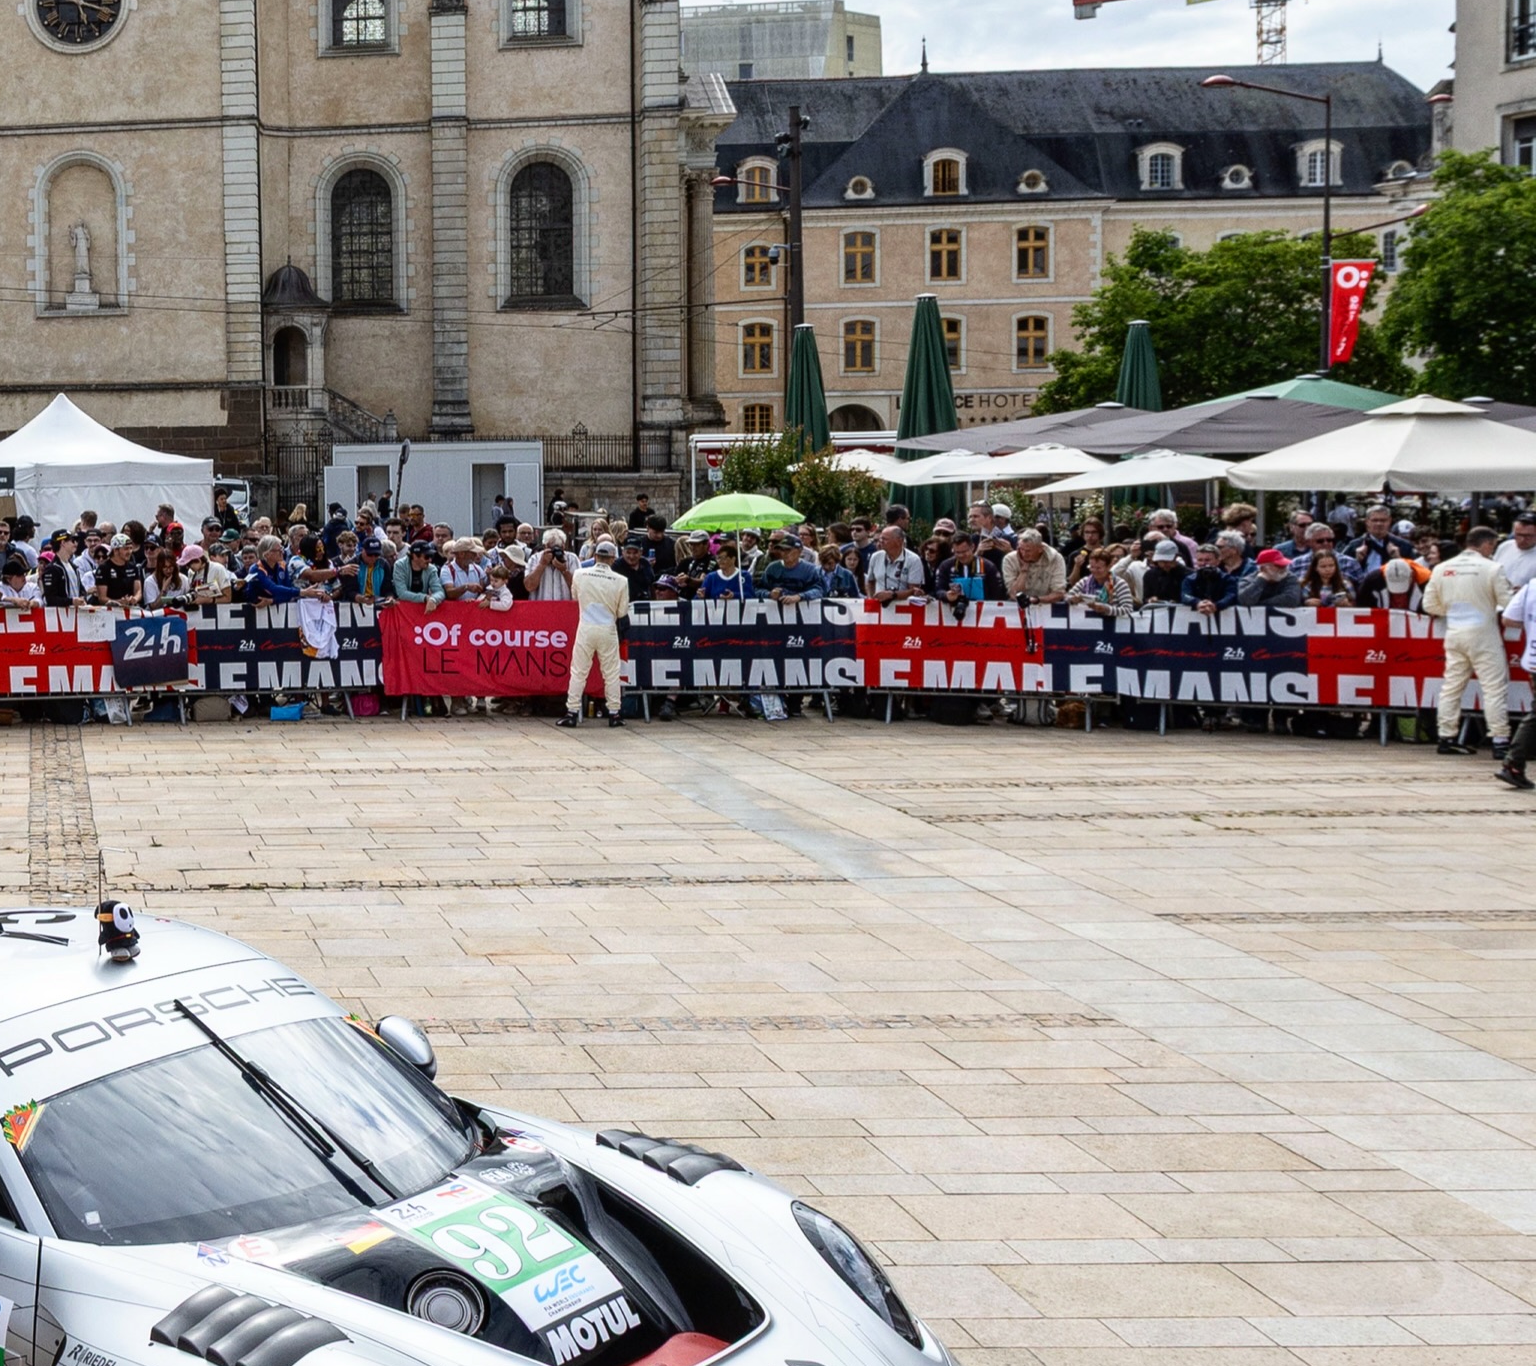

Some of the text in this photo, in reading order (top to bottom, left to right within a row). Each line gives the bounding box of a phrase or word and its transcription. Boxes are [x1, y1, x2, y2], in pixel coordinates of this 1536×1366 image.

[123, 621, 182, 660] 24h
[414, 622, 568, 648] :Of course
[258, 659, 384, 689] MAN
[423, 648, 568, 677] LE MANS
[390, 1203, 427, 1220] 24h
[431, 1205, 576, 1281] 92
[533, 1265, 586, 1303] WEC
[546, 1296, 642, 1366] MOTUL
